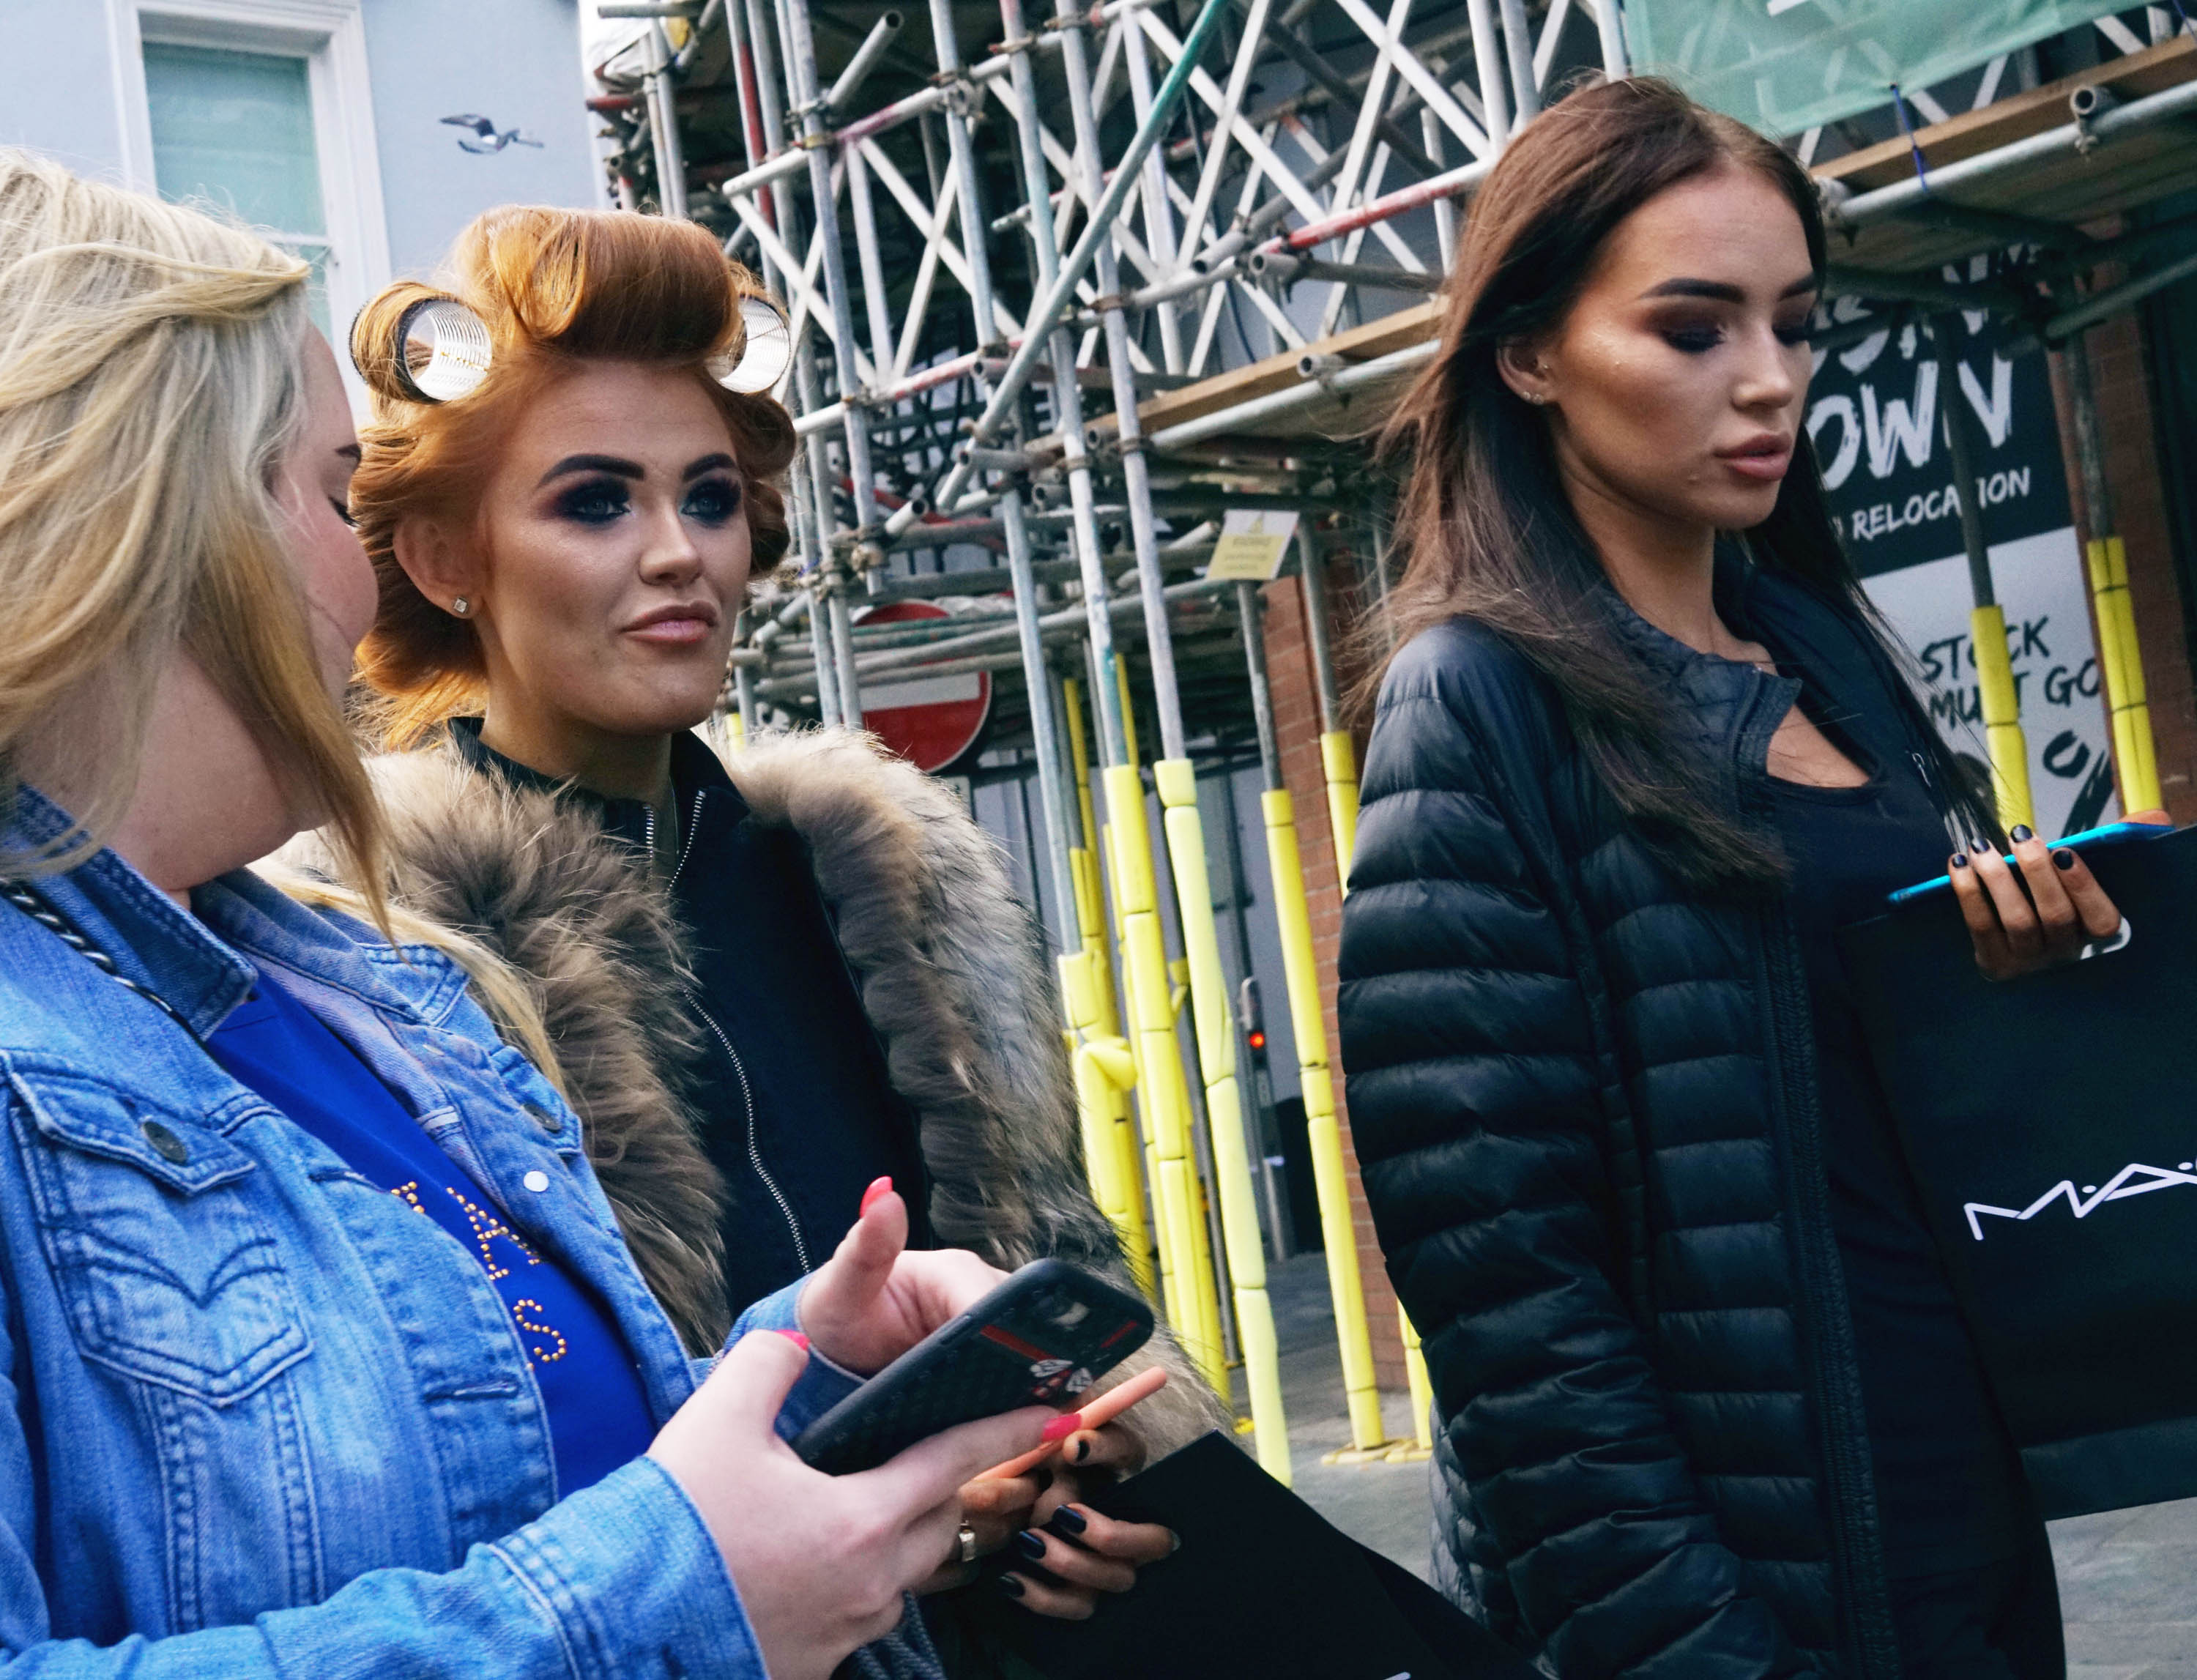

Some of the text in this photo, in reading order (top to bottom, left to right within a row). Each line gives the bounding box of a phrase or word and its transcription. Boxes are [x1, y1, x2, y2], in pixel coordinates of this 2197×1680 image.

[1851, 466, 2031, 541] RELOCAION
[1929, 658, 2100, 730] MUT GO
